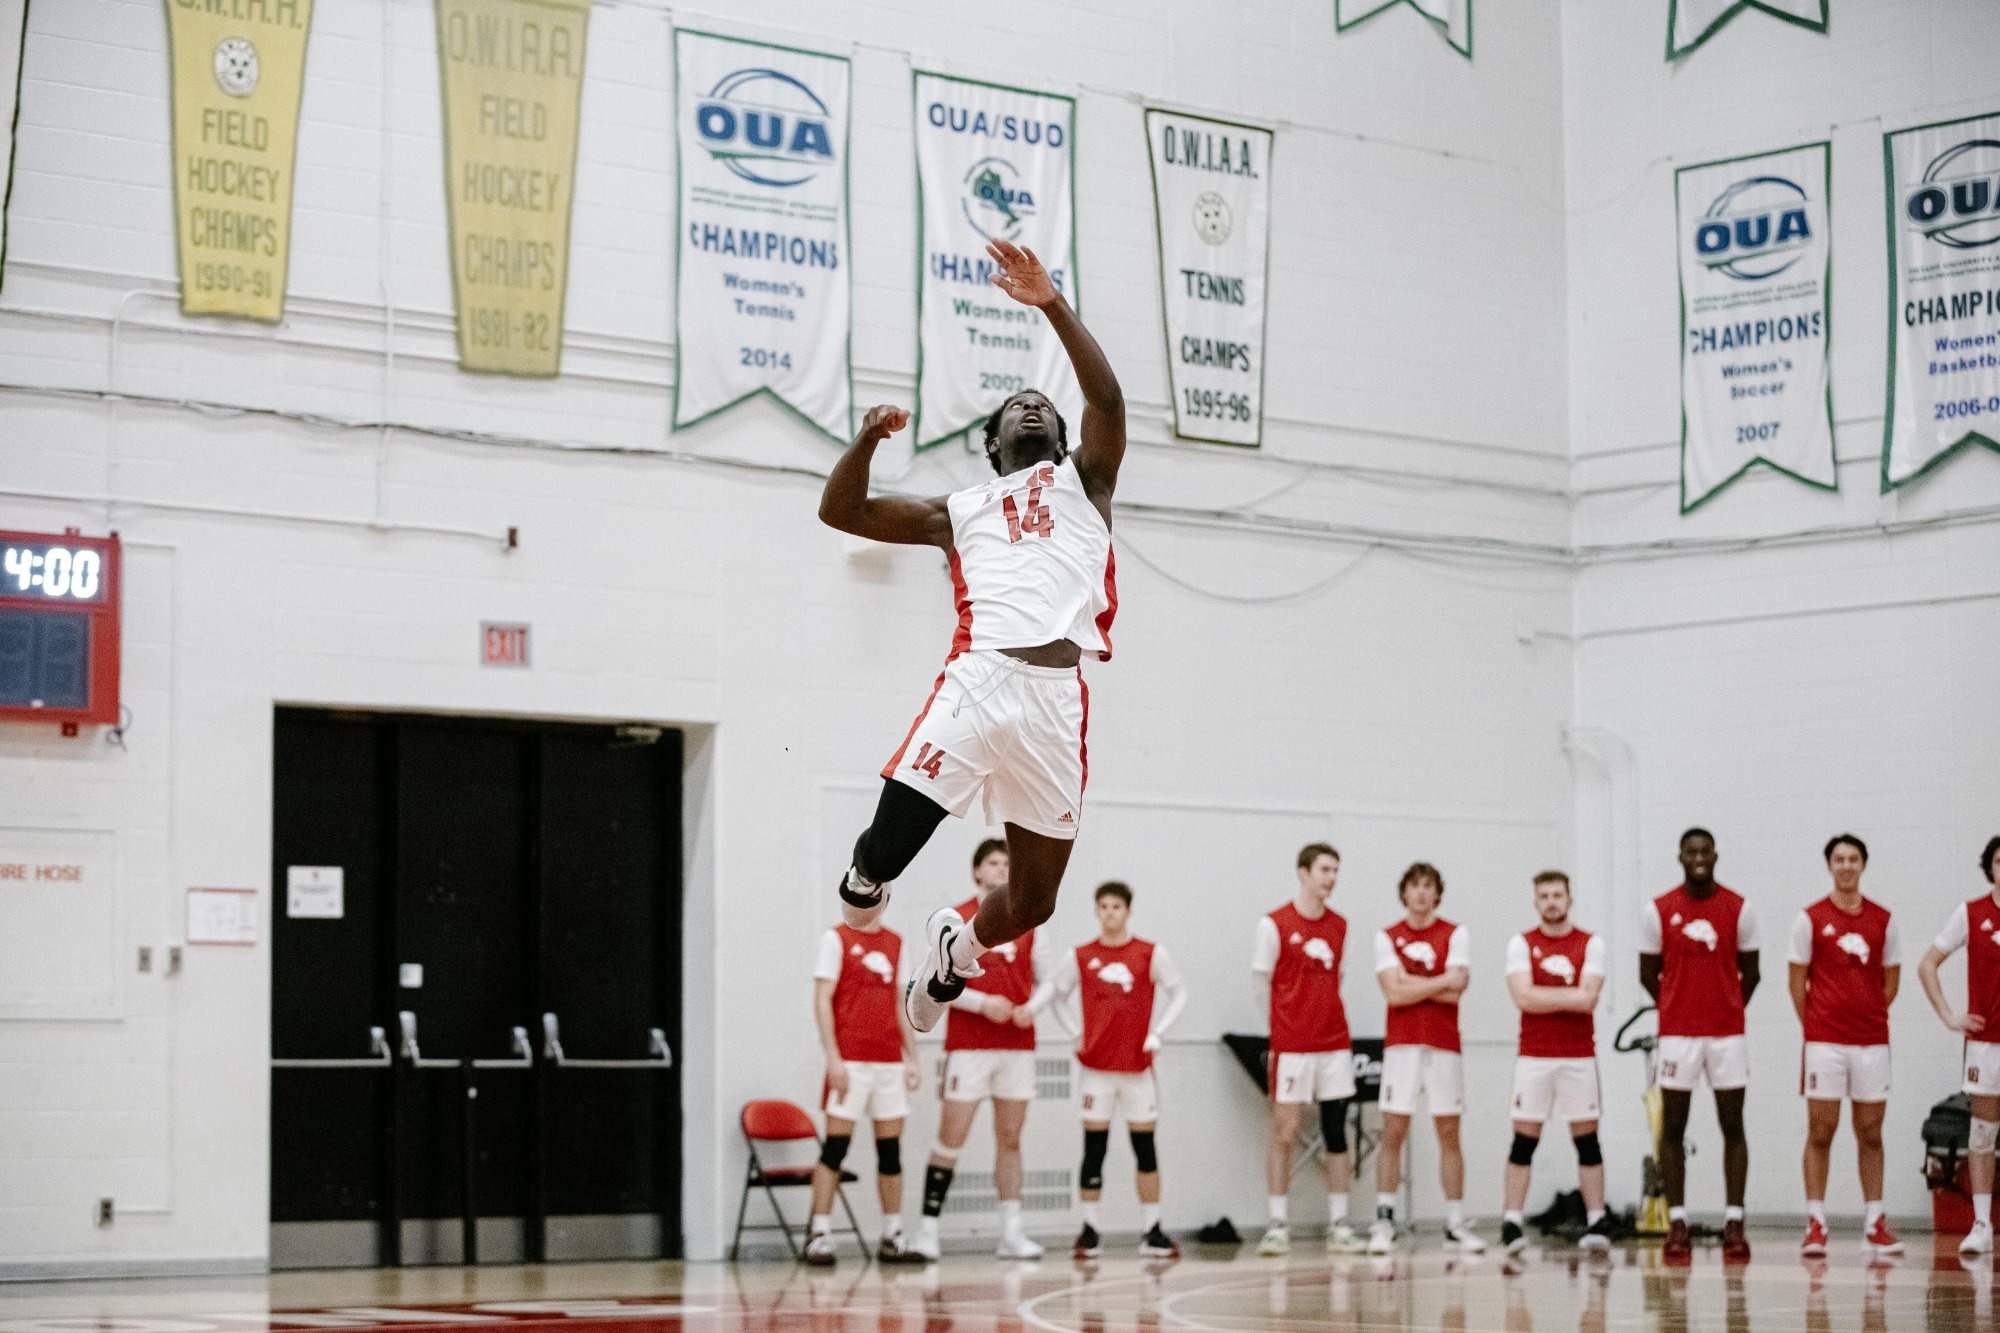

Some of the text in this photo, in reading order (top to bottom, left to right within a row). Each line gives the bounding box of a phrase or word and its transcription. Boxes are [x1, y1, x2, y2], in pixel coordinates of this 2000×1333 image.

[202, 107, 268, 152] FIELD
[481, 94, 547, 142] FIELD
[697, 105, 833, 156] OUA
[929, 103, 1064, 148] OUA/SUO
[1164, 125, 1258, 179] O.W.I.A.A.
[187, 155, 280, 203] HOCKEY
[463, 161, 560, 214] HOCKEY
[1907, 176, 2000, 222] OU
[190, 206, 278, 257] CHAMPS
[690, 221, 839, 270] CHAMPIONS
[1696, 208, 1812, 255] OUA
[465, 232, 555, 291] CHAMPS
[723, 273, 806, 299] Women's
[1180, 268, 1246, 307] TENNIS
[733, 297, 796, 322] Tennis
[739, 347, 792, 371] 2014
[966, 326, 1032, 352] Tennis
[1181, 335, 1251, 374] CHAMPS
[1928, 353, 2000, 375] Basketb
[1183, 387, 1251, 423] 1995-96
[1735, 421, 1781, 444] 2007
[1003, 486, 1055, 544] 14
[4, 547, 100, 599] 4:00
[486, 625, 526, 664] EXIT
[911, 741, 946, 780] 14
[0, 864, 83, 882] IRE HOSE
